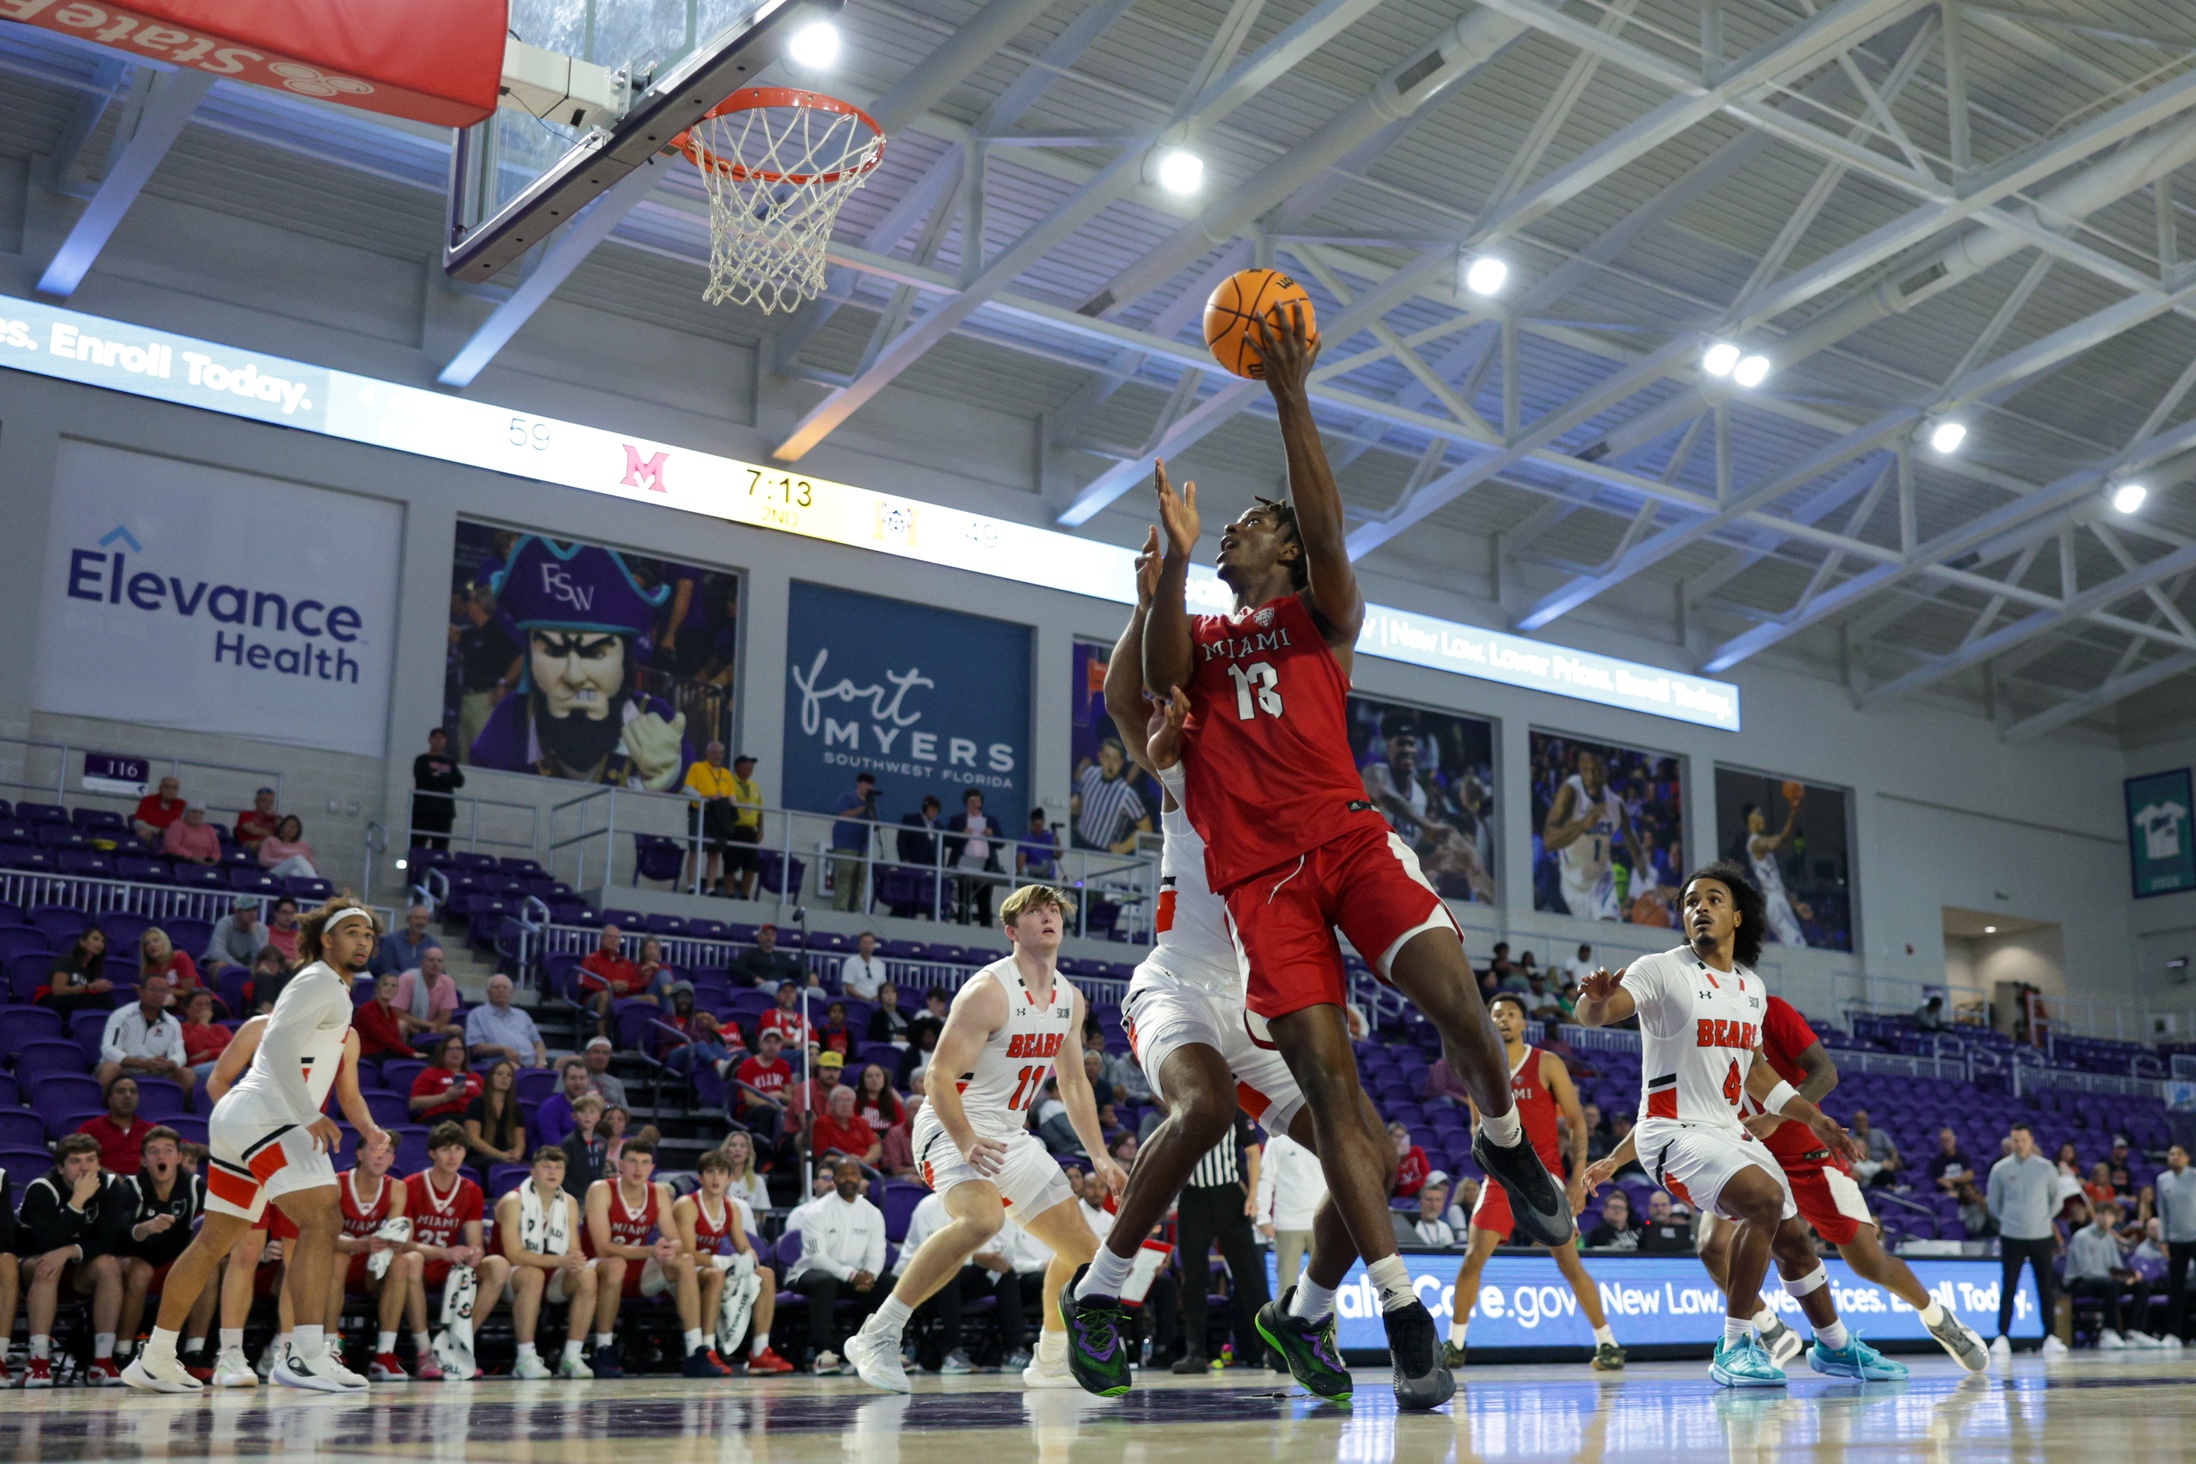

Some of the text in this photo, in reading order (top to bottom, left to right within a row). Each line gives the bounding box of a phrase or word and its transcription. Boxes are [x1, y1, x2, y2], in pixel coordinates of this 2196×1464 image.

[55, 3, 264, 73] State
[50, 322, 172, 379] Enroll
[182, 351, 312, 415] Today.
[509, 417, 550, 450] 59
[746, 468, 812, 507] 7:13
[761, 506, 799, 528] 2ND
[965, 521, 999, 549] 49
[67, 548, 363, 643] Elevance
[541, 562, 594, 611] FSW
[1201, 627, 1291, 662] MIAMI
[1391, 621, 1439, 652] New
[215, 631, 359, 684] Health
[792, 648, 934, 736] fort
[1227, 661, 1285, 721] 13
[824, 717, 1015, 773] MYERS
[109, 760, 138, 778] 116
[823, 751, 1013, 789] SOUTHWEST FLORIDA
[1006, 1033, 1065, 1058] BEARS
[1697, 1019, 1757, 1052] BEARS
[1008, 1065, 1046, 1111] 11
[1723, 1056, 1741, 1106] 4
[417, 1214, 460, 1229] MIAMI
[1599, 1281, 1660, 1315] New
[1665, 1281, 1725, 1314] Law.
[1957, 1280, 2033, 1320] Tody.
